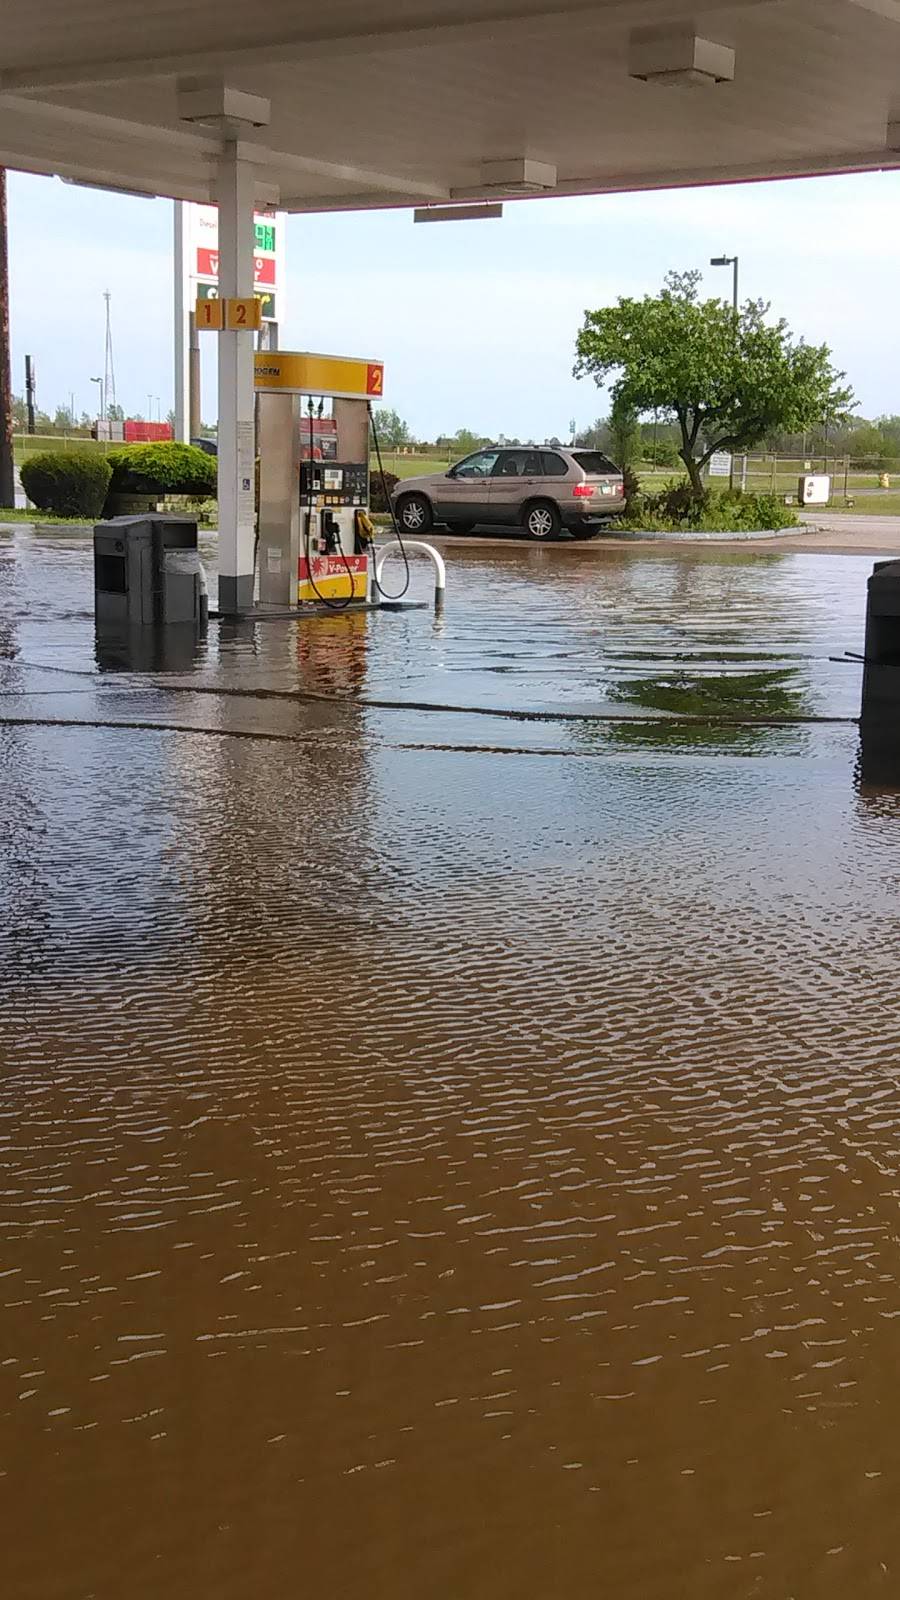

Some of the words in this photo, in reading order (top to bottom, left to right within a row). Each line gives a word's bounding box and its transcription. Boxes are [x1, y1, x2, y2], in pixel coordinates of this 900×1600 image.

[204, 304, 211, 323] 1
[236, 305, 246, 324] 2
[372, 369, 382, 392] 2
